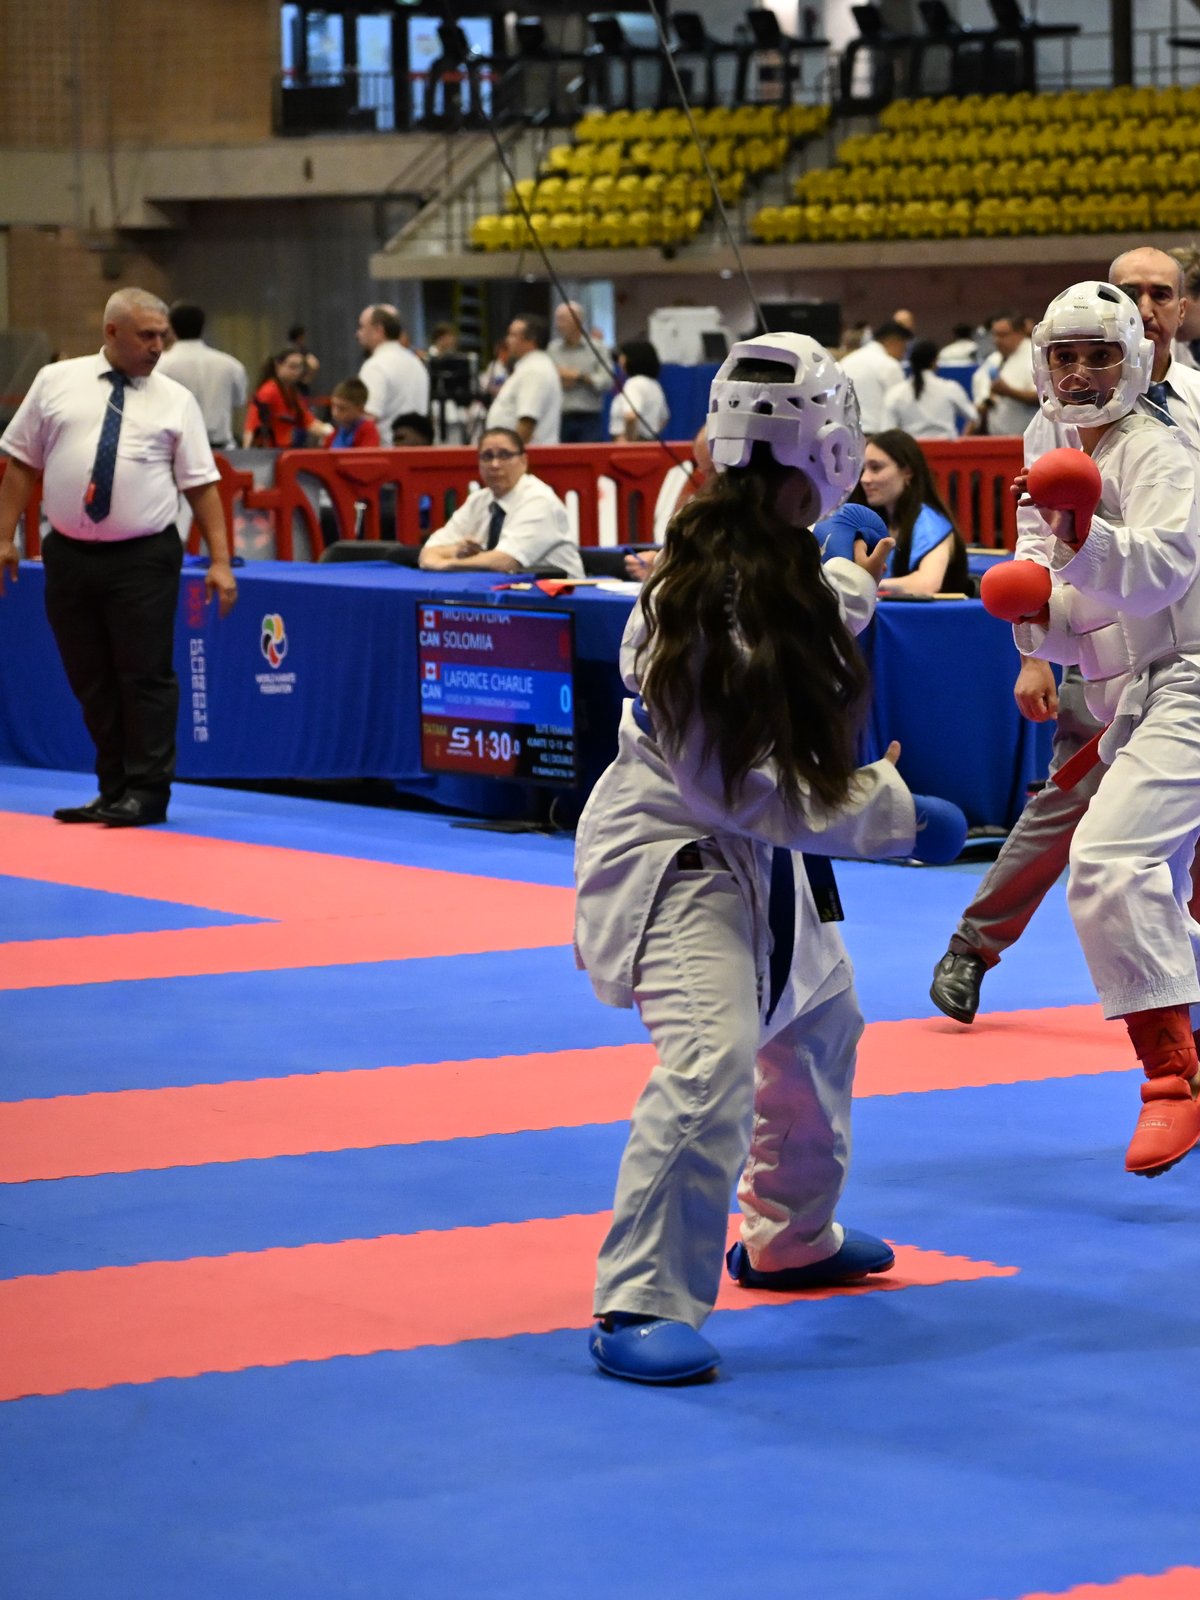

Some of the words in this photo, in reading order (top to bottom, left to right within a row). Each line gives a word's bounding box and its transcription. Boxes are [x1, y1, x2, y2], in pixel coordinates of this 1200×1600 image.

[419, 630, 440, 647] CAN
[421, 683, 441, 699] CAN
[444, 671, 488, 691] LAFORCE
[491, 673, 533, 694] CHARLIE
[560, 684, 571, 713] 0
